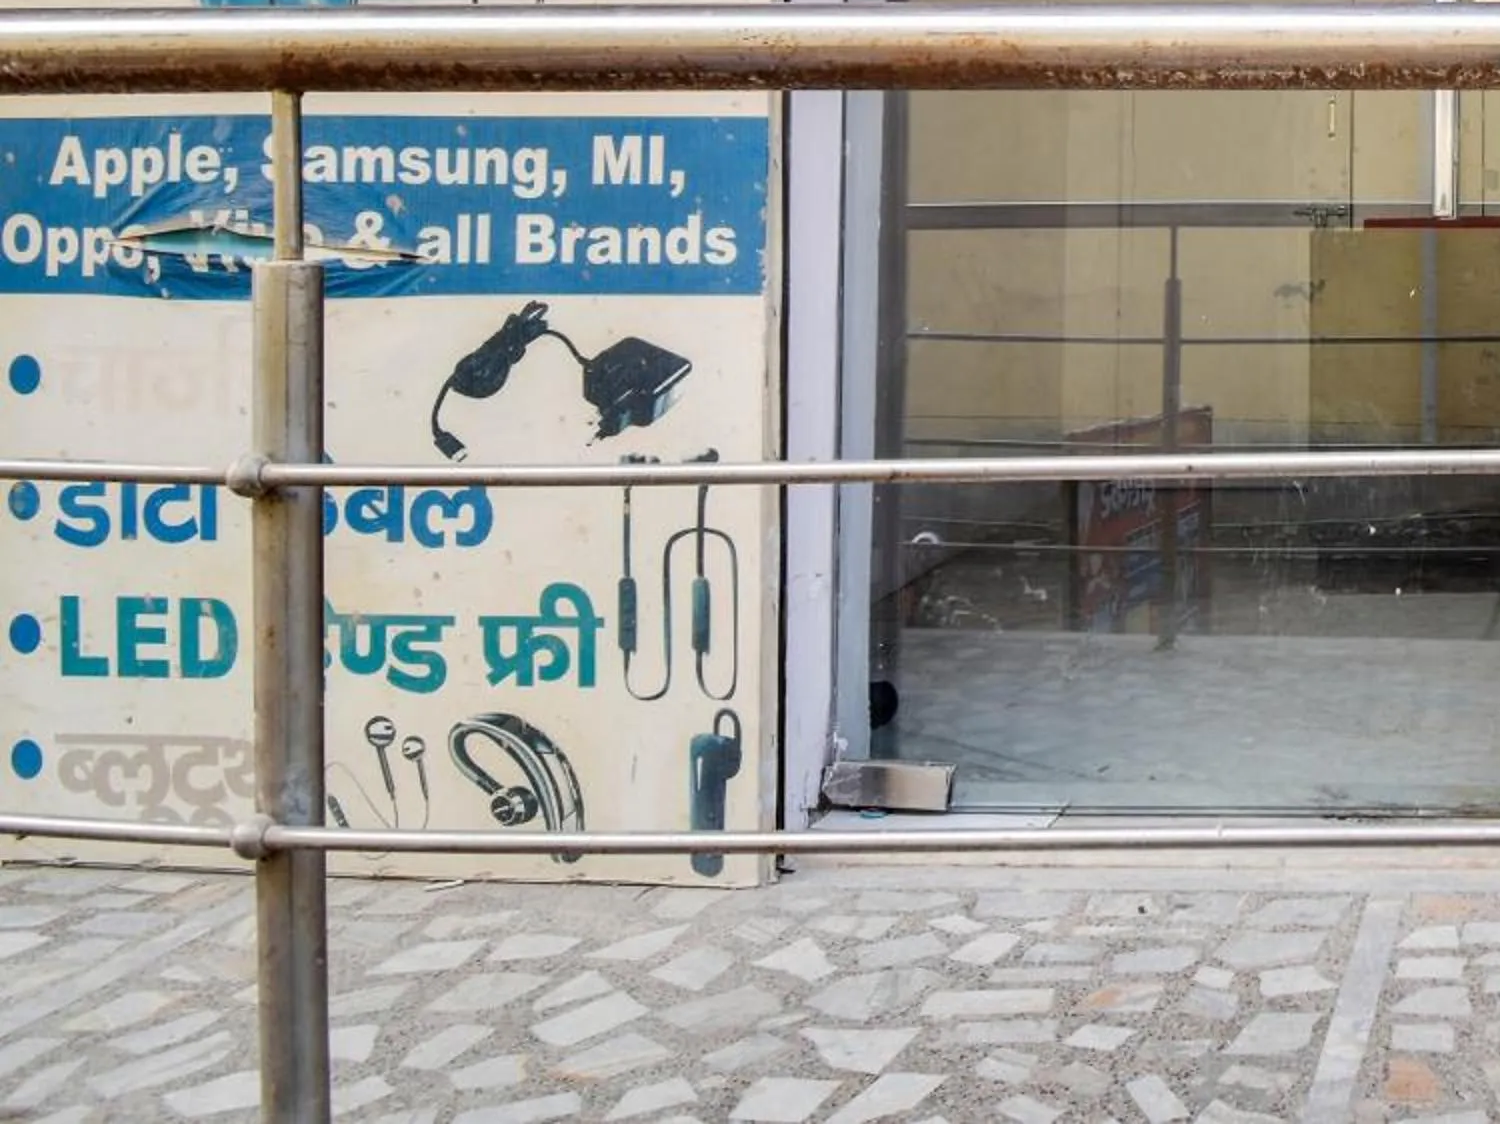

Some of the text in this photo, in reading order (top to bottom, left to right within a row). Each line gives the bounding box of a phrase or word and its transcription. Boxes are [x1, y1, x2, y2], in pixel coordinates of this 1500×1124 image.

[48, 133, 239, 199] Apple,
[592, 136, 688, 197] MI,
[416, 215, 490, 266] all
[515, 215, 738, 267] Brands
[59, 596, 239, 678] LED
[478, 582, 605, 688] फ्री
